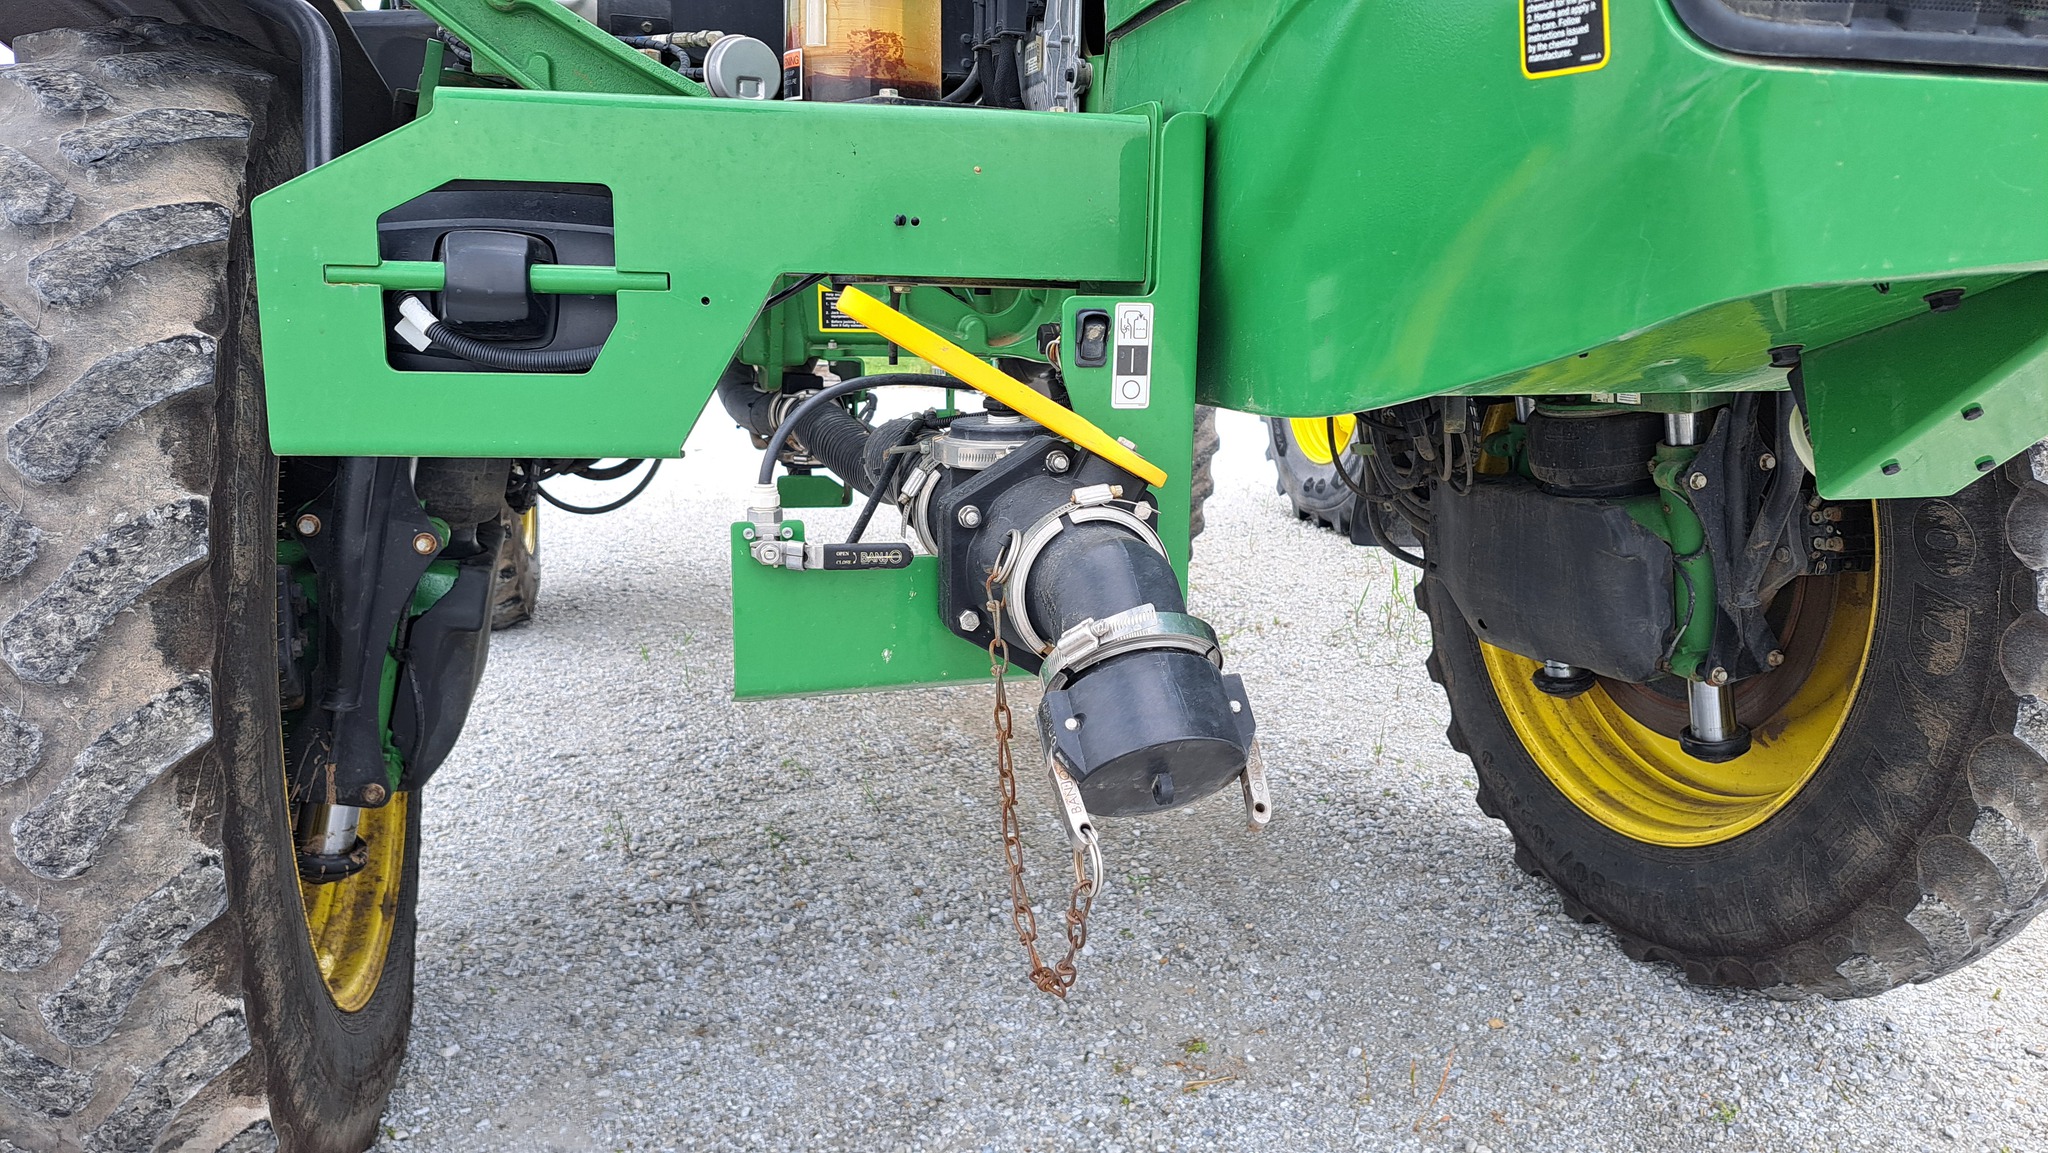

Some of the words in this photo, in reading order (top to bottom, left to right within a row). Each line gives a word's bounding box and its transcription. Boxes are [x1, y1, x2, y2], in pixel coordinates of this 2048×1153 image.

[1527, 15, 1534, 24] 2.
[1534, 10, 1556, 22] Handle
[1557, 8, 1570, 18] and
[1570, 4, 1590, 16] apply
[1528, 22, 1541, 33] with
[1558, 16, 1582, 28] Follow
[1528, 29, 1566, 43] instructions
[1566, 24, 1590, 36] issued
[1528, 44, 1536, 53] by
[1537, 40, 1548, 52] the
[1548, 36, 1578, 50] chemical
[1528, 48, 1573, 63] manufacturer.
[860, 549, 903, 565] BANJO
[1060, 770, 1082, 814] BANJO
